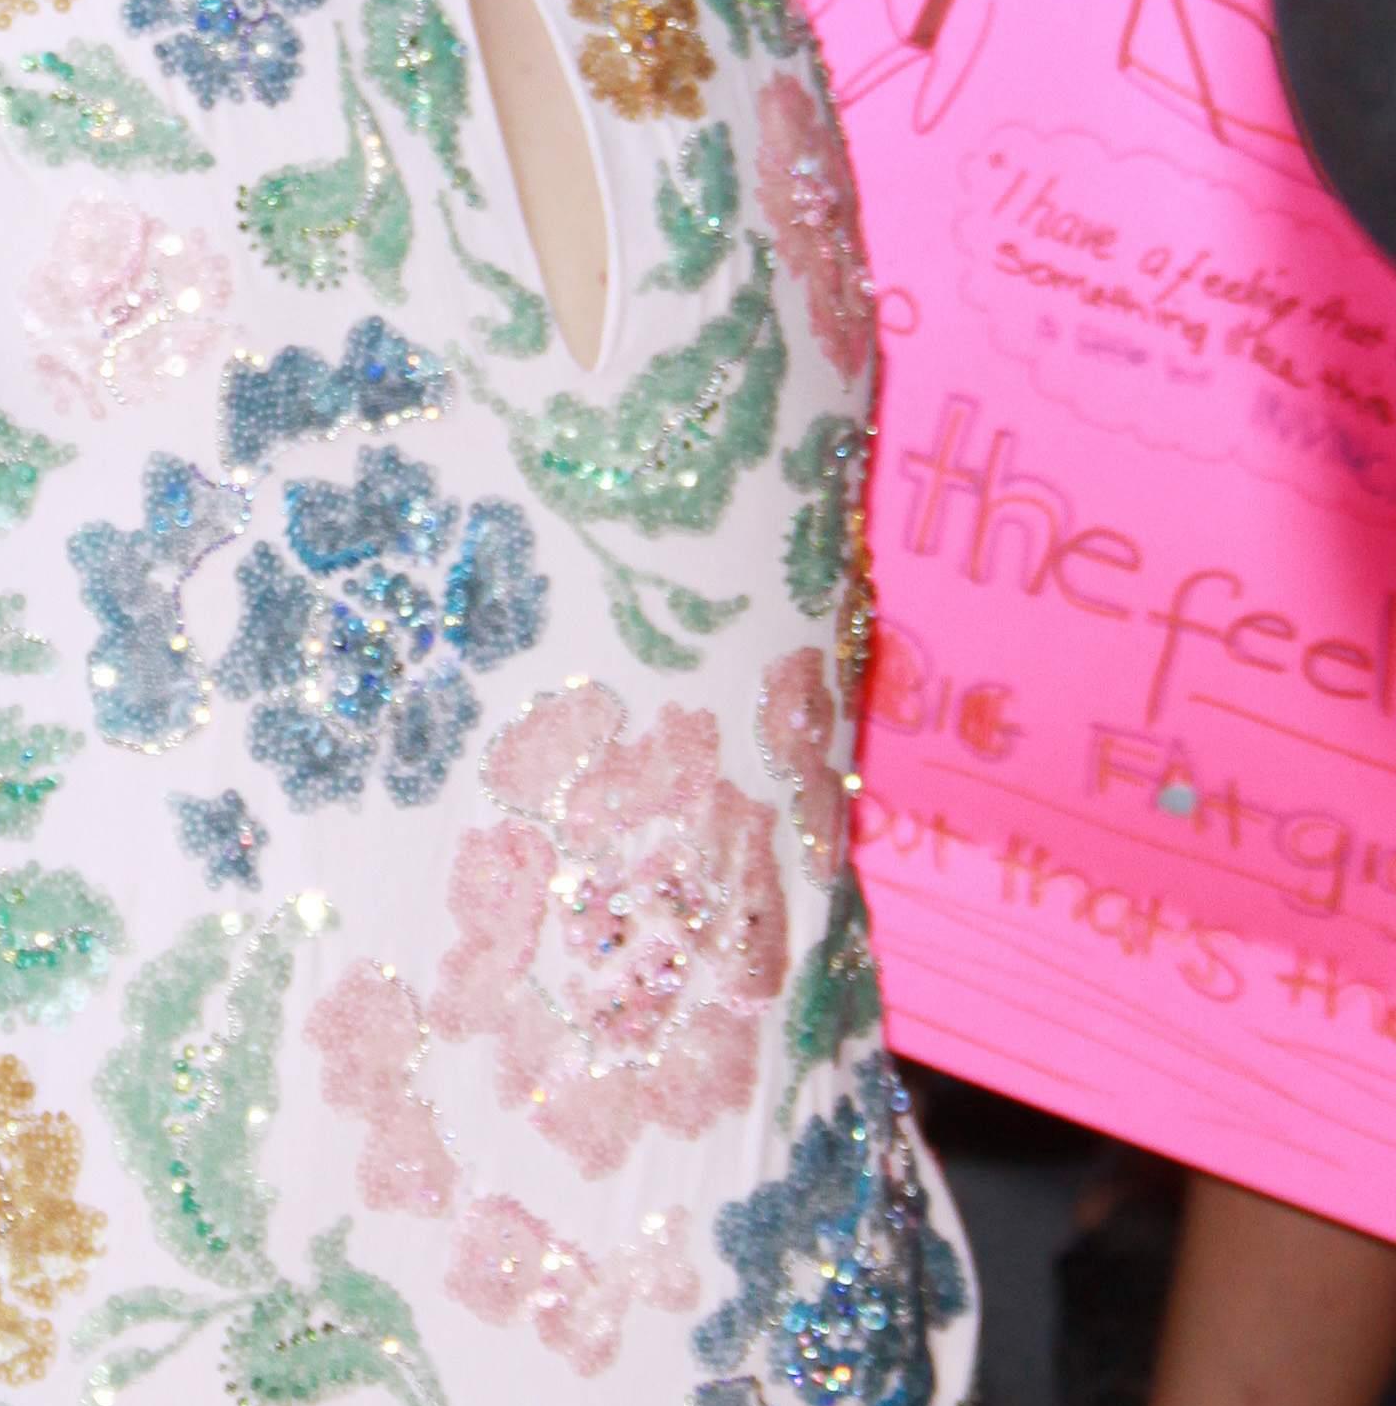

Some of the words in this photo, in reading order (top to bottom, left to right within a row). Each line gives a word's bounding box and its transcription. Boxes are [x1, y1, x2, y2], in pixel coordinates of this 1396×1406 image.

[1016, 173, 1119, 261] have
[1136, 246, 1173, 279] a
[899, 394, 1143, 621] the
